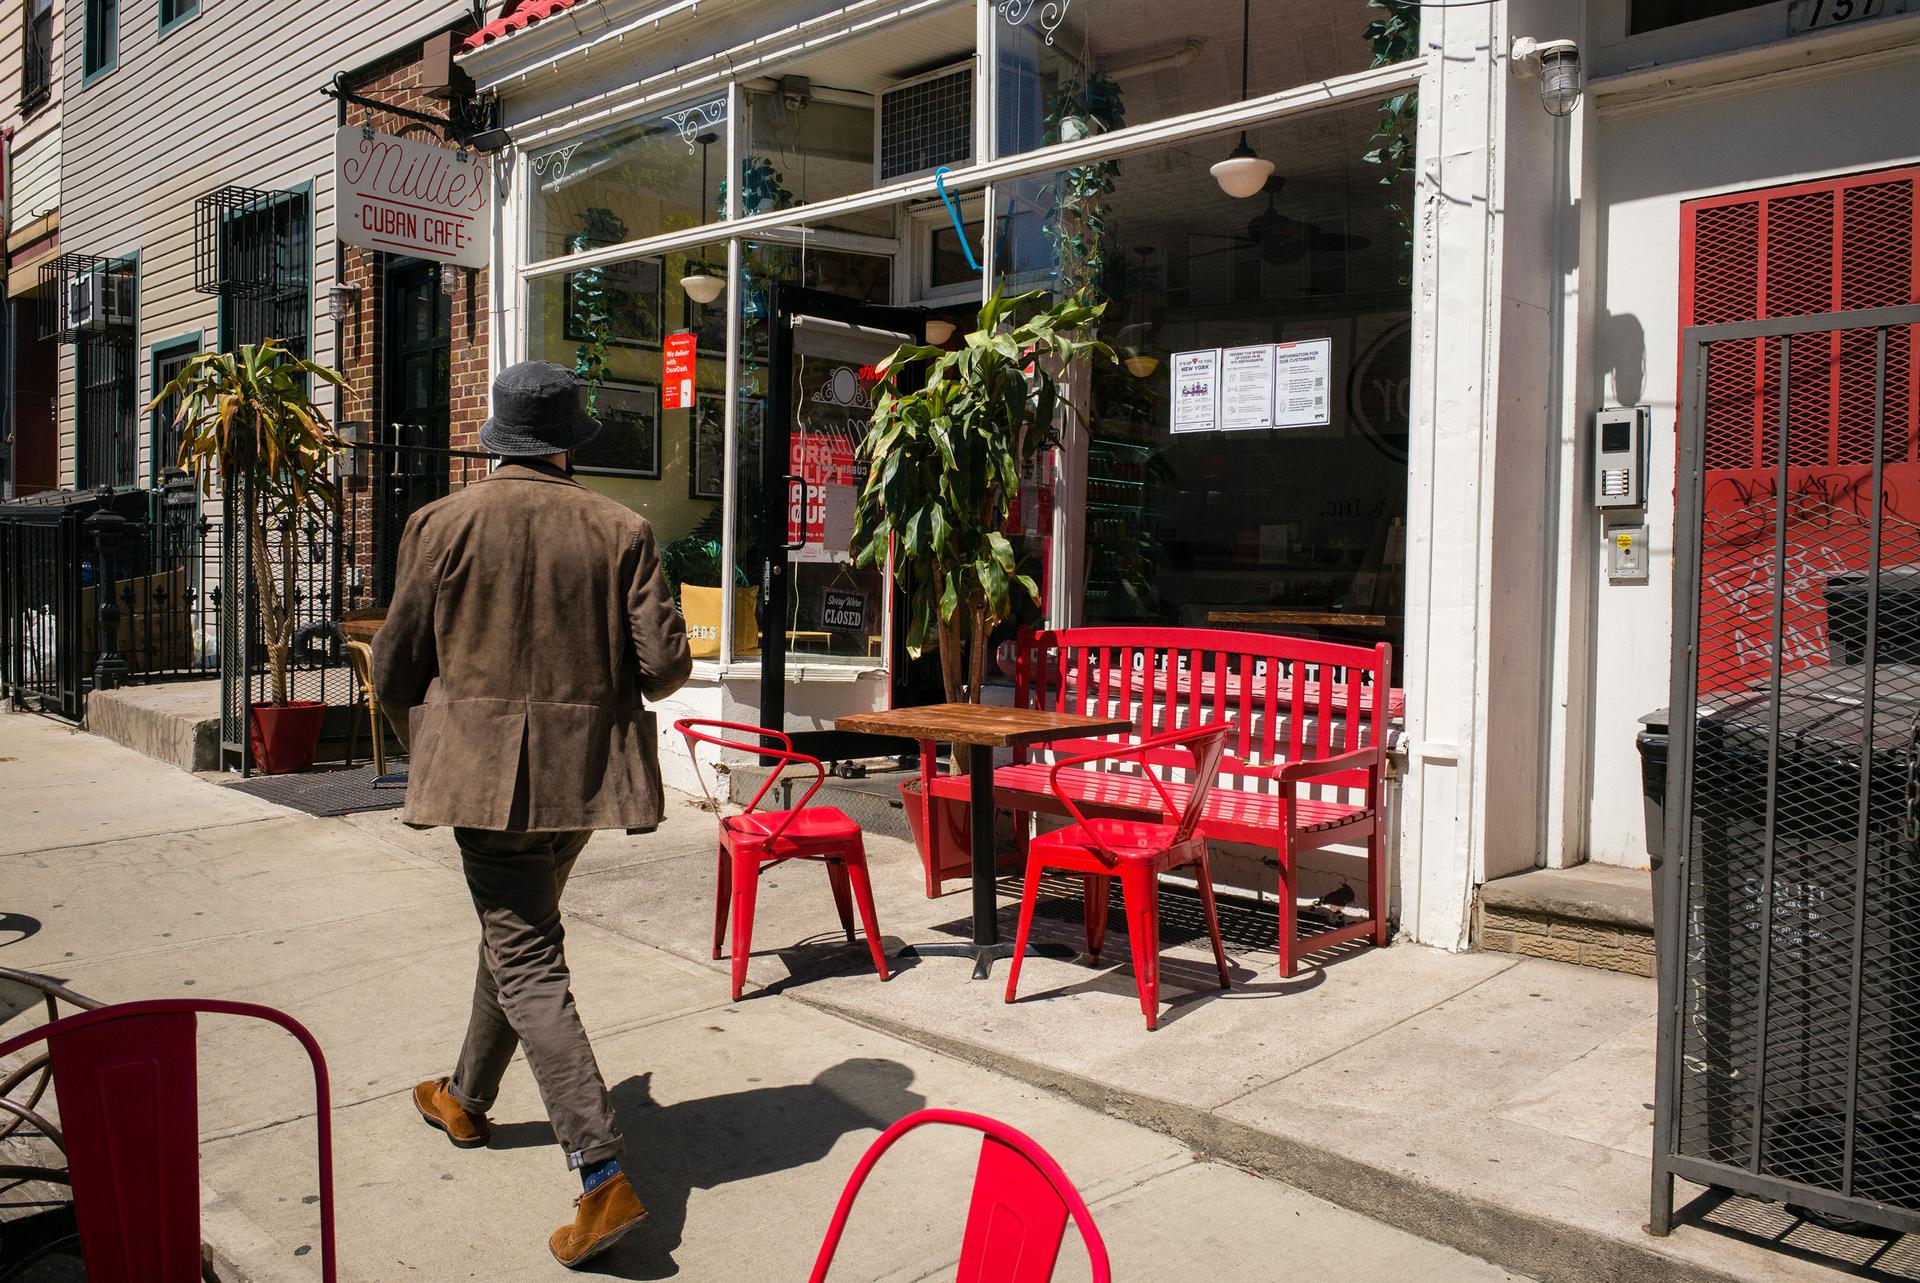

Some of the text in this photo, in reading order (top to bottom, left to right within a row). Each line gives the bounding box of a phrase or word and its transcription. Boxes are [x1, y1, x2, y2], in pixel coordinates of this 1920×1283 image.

[343, 138, 487, 212] Millie's
[362, 204, 465, 249] CUBAN CAFÉ
[666, 366, 688, 374] DoorDash
[792, 444, 833, 465] ORA
[788, 504, 826, 524] OUR
[828, 595, 845, 609] Sorry
[825, 609, 861, 626] CLOSED
[1255, 660, 1375, 689] PASTIS
